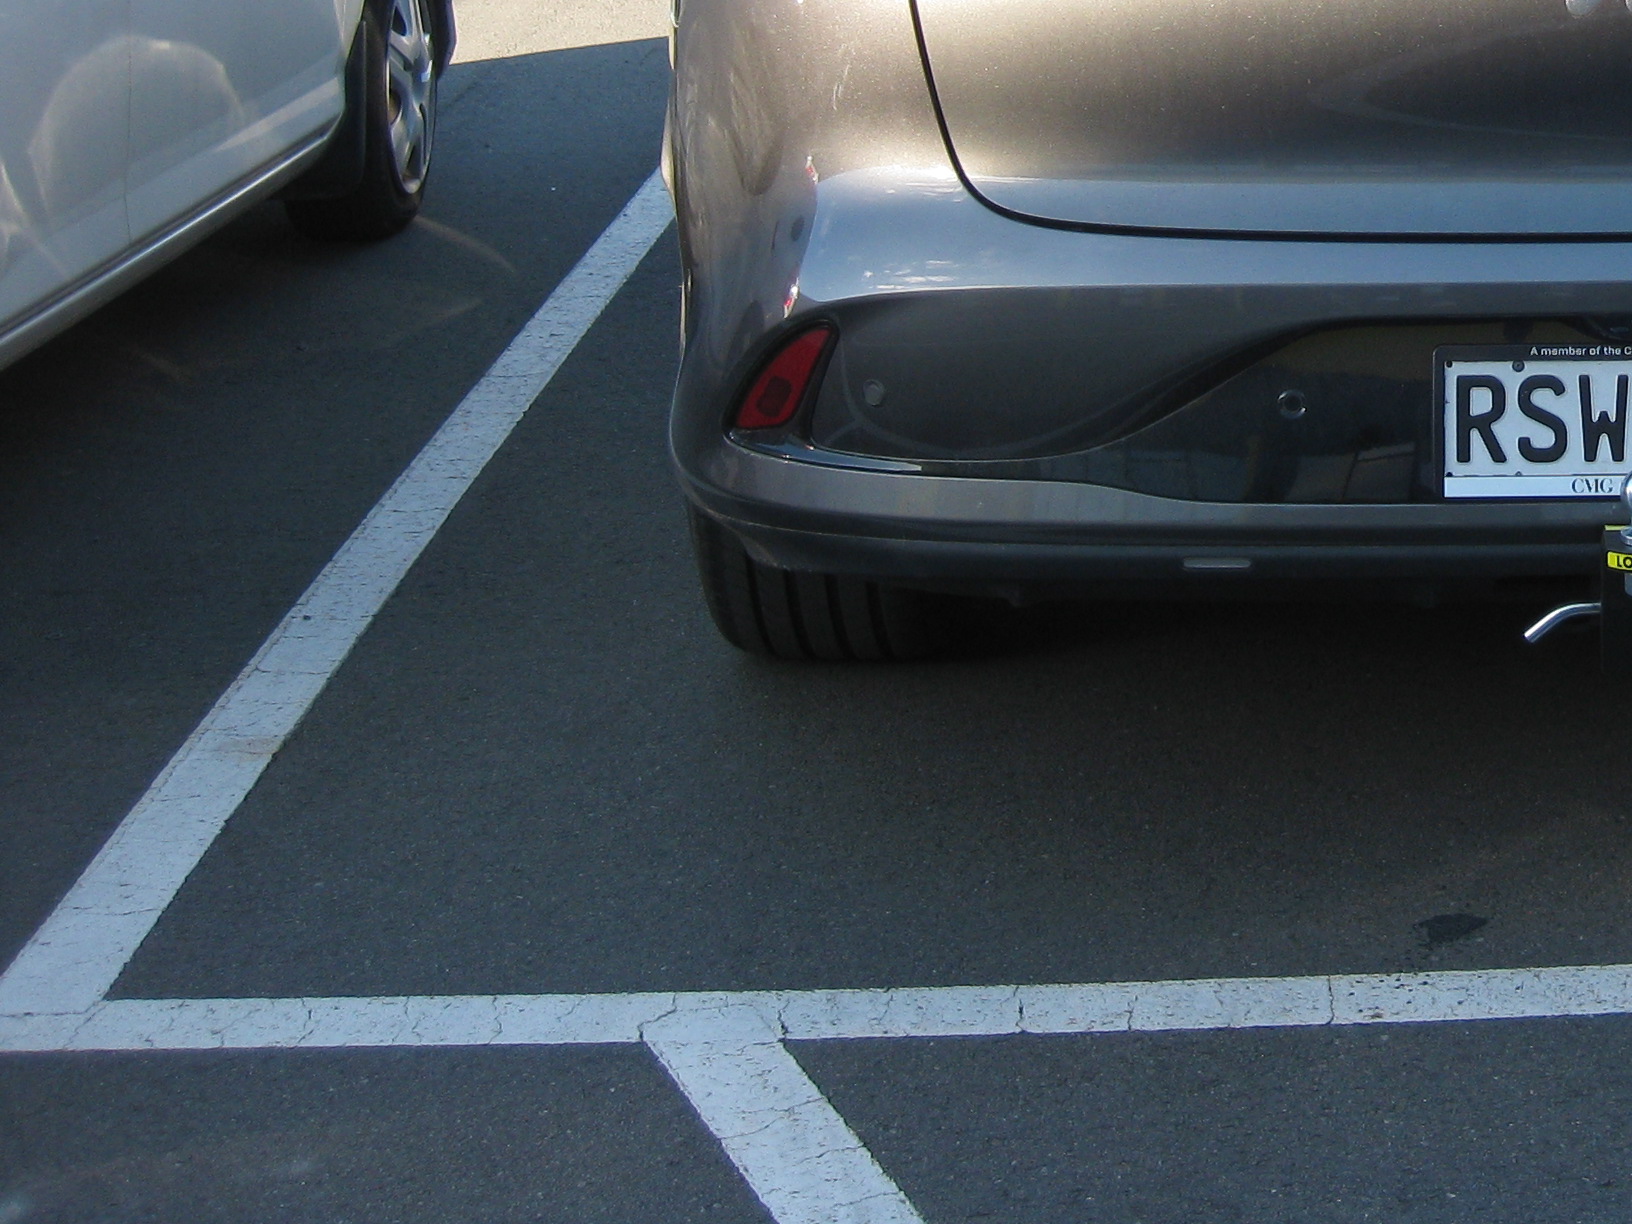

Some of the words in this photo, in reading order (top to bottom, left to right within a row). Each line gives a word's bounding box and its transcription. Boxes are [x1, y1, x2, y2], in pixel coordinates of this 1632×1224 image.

[1530, 347, 1539, 356] A
[1541, 347, 1586, 356] member
[1589, 346, 1600, 356] of
[1603, 346, 1621, 356] the
[1571, 478, 1613, 494] CMG
